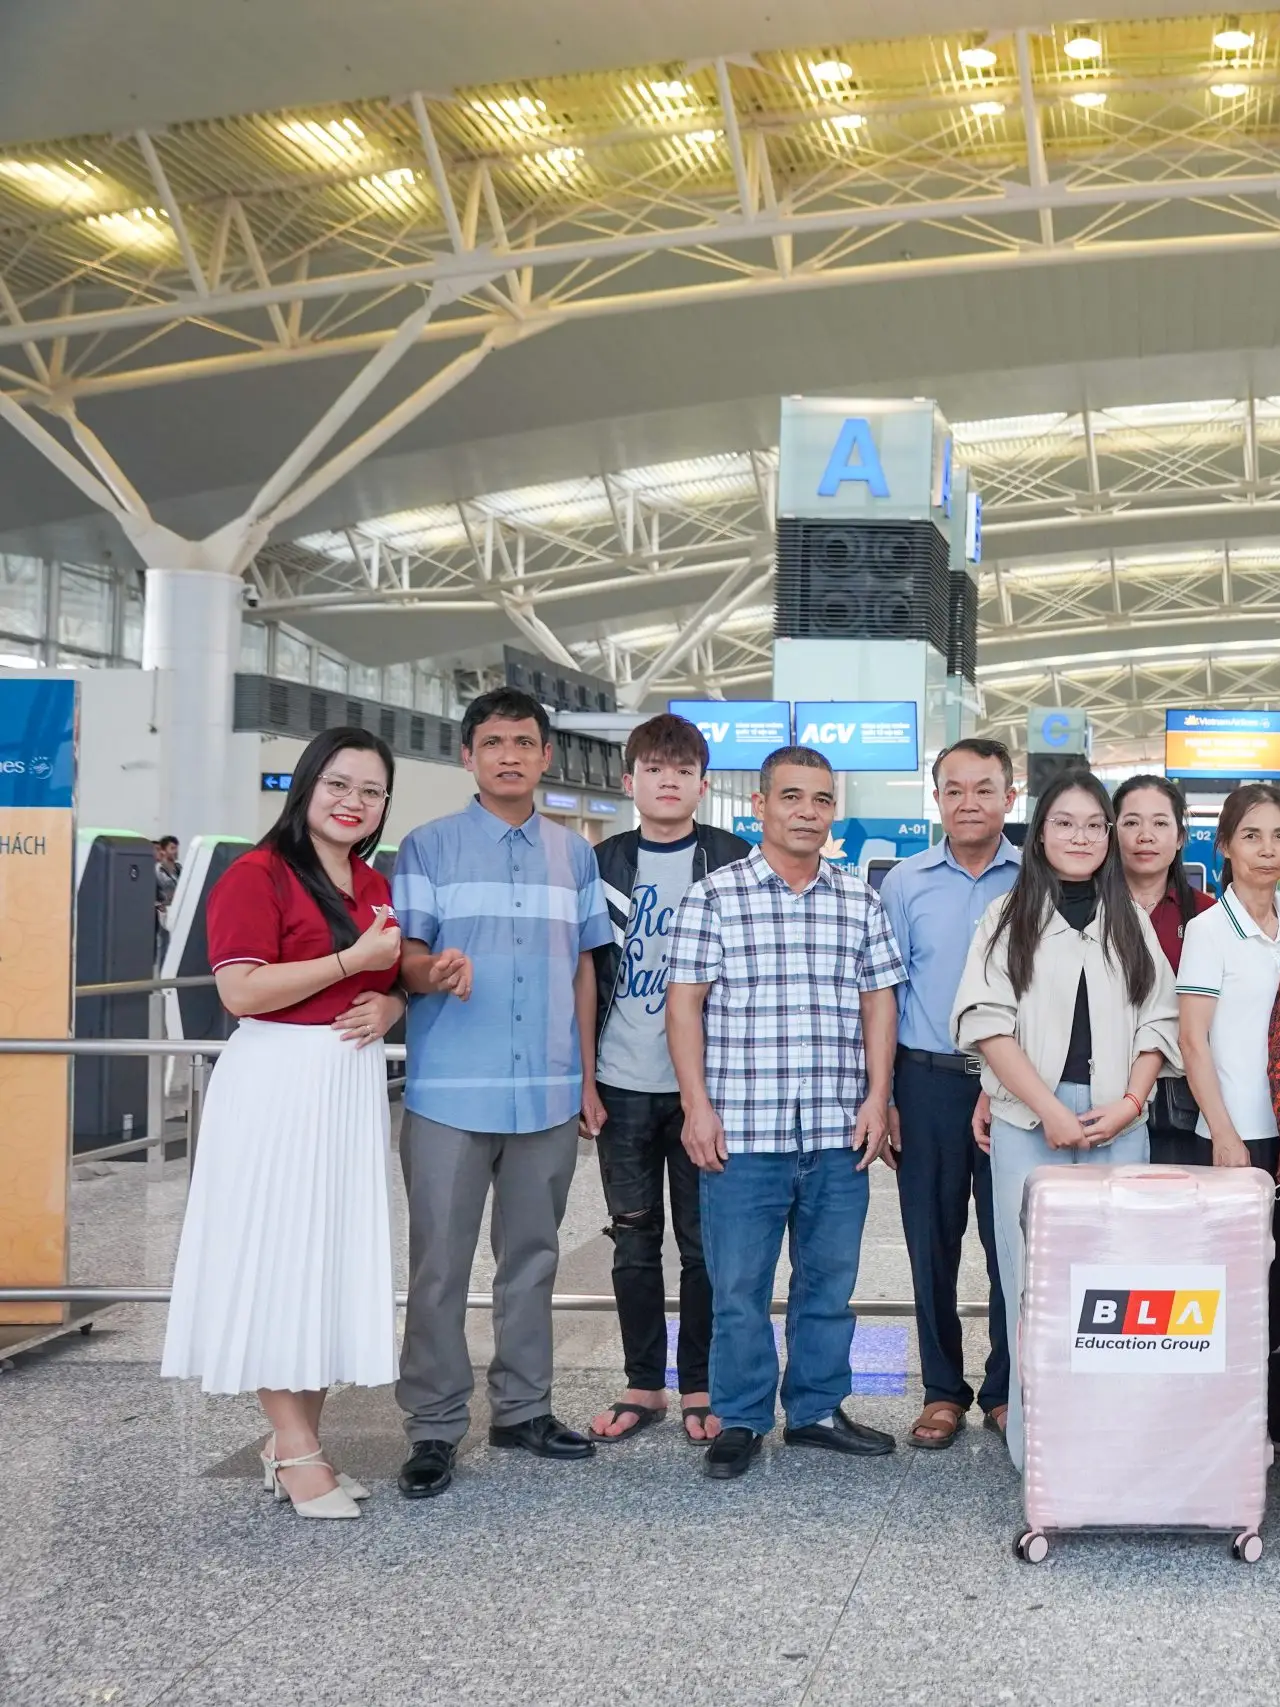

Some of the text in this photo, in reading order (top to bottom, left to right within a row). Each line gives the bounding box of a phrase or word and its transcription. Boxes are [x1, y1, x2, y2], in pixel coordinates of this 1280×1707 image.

[817, 418, 891, 498] A
[800, 722, 856, 744] ACV
[1042, 713, 1070, 748] C
[898, 823, 927, 835] A-01
[1188, 830, 1211, 841] -02
[1092, 1299, 1204, 1325] BLA
[1074, 1337, 1210, 1352] Education Group
